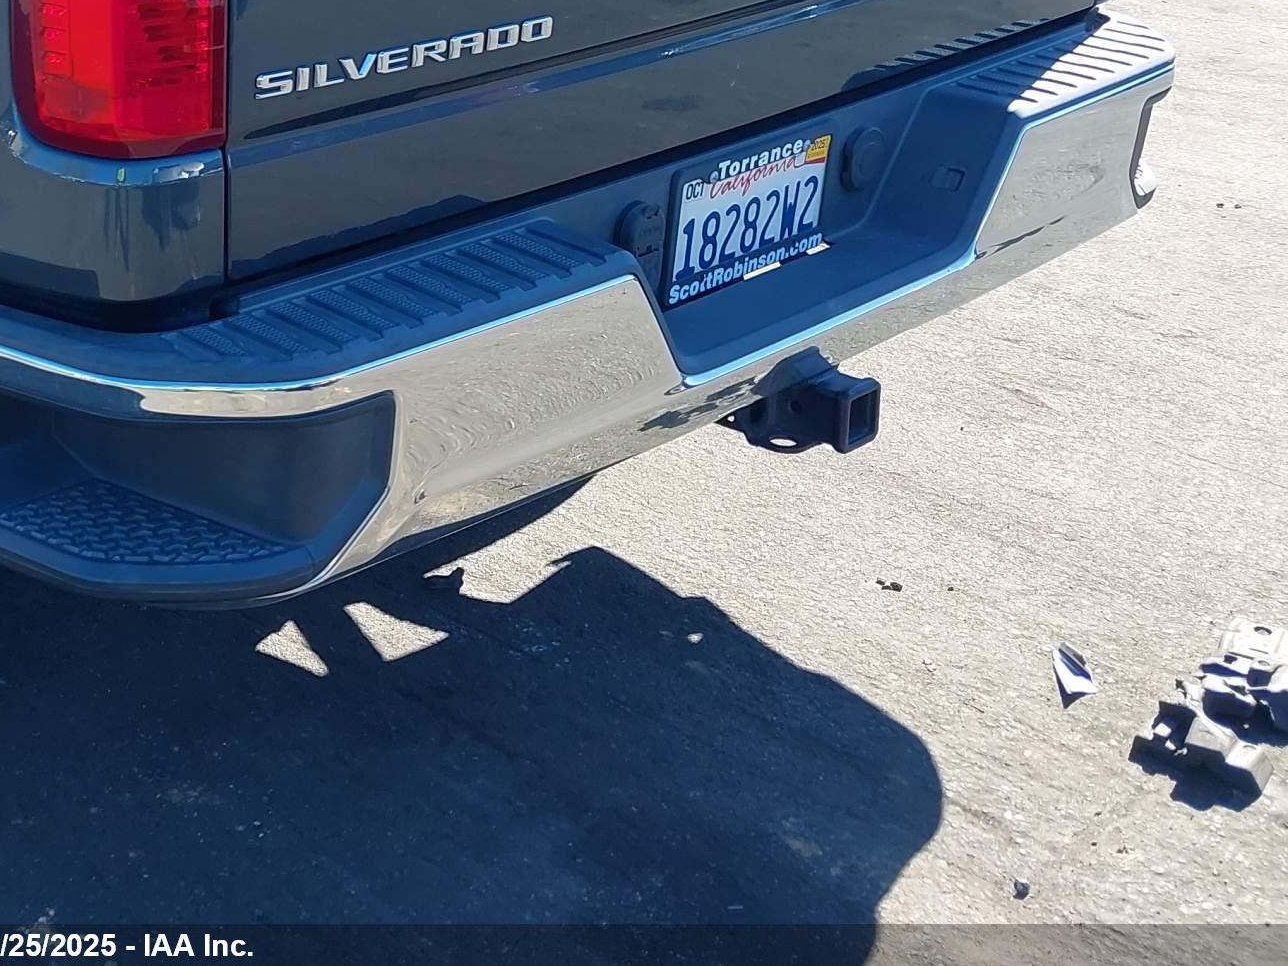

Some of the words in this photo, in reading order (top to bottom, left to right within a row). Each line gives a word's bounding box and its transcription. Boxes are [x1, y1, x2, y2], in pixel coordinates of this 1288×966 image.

[253, 15, 554, 101] SILVERADO
[718, 140, 803, 180] Torrance
[674, 175, 820, 281] 18282W2
[668, 232, 824, 304] ScottRobinson.com
